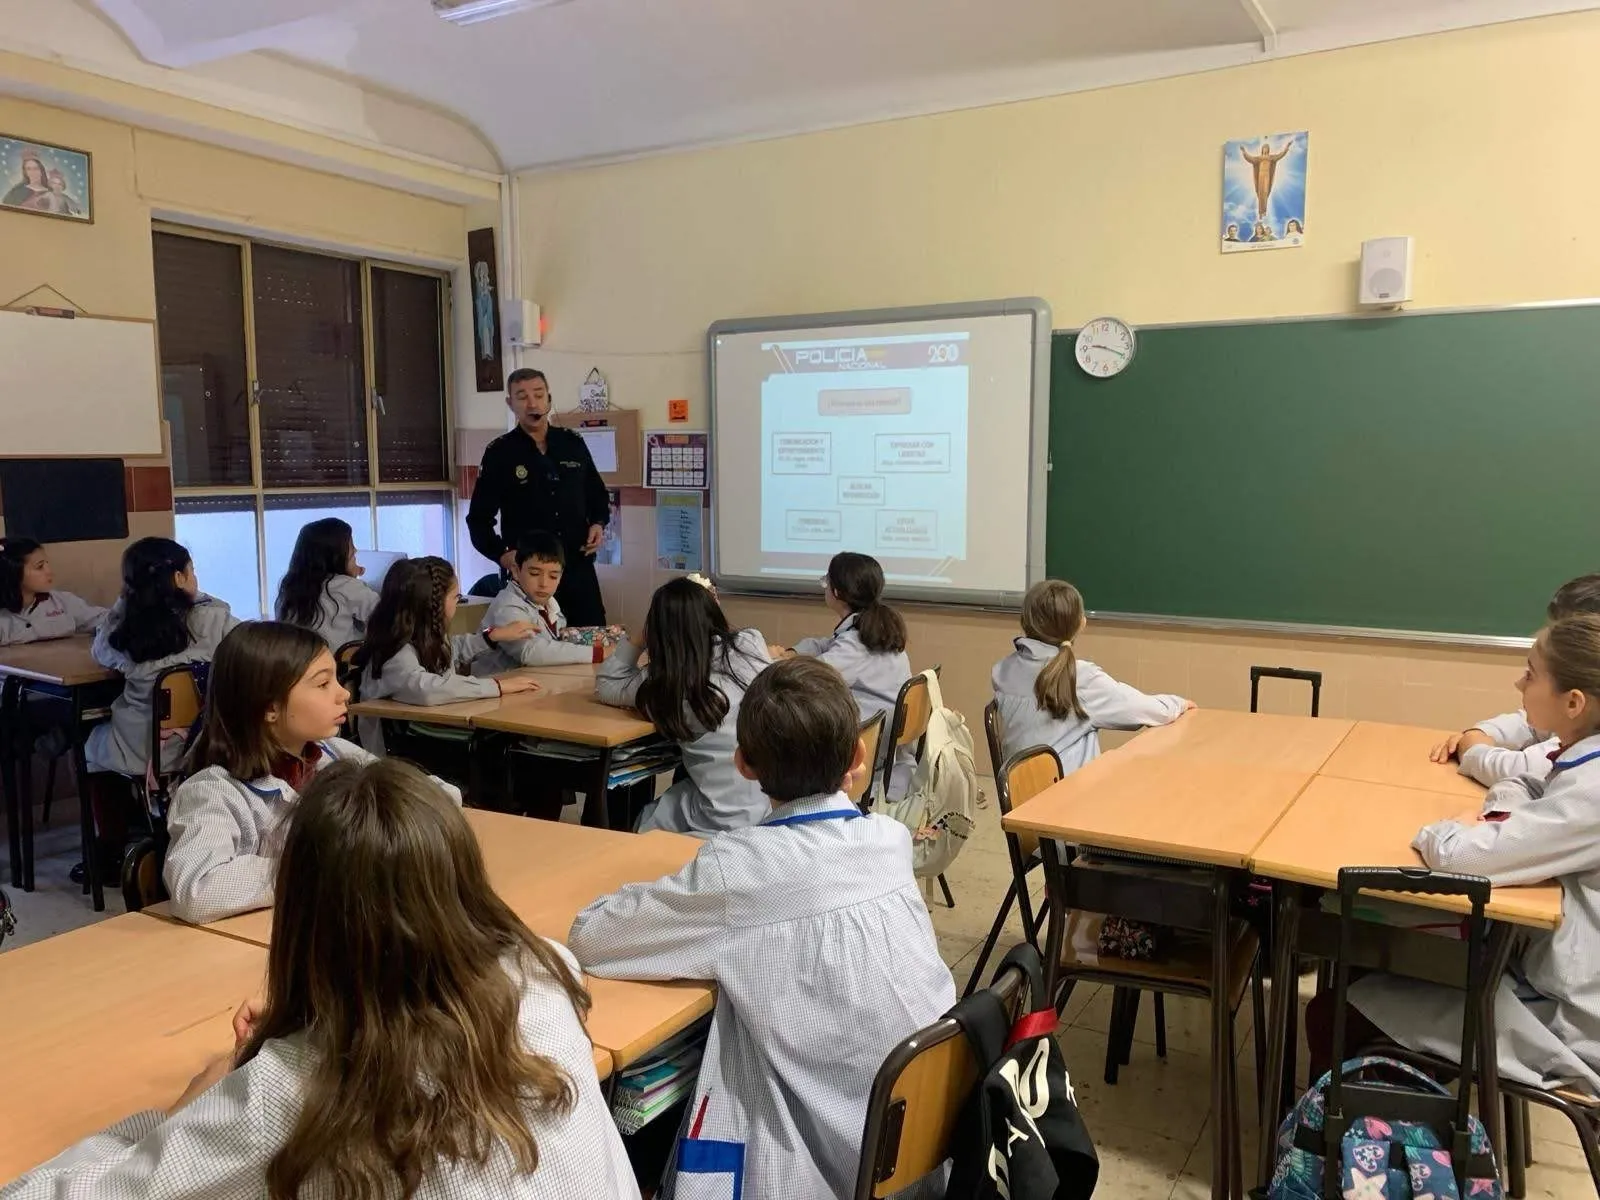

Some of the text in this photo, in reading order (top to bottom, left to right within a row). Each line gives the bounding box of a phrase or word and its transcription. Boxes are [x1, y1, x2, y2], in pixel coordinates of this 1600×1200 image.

[1101, 322, 1109, 332] 12
[1120, 332, 1126, 341] 2
[1082, 345, 1088, 353] 9
[1124, 342, 1130, 350] 3
[1102, 362, 1109, 372] 6
